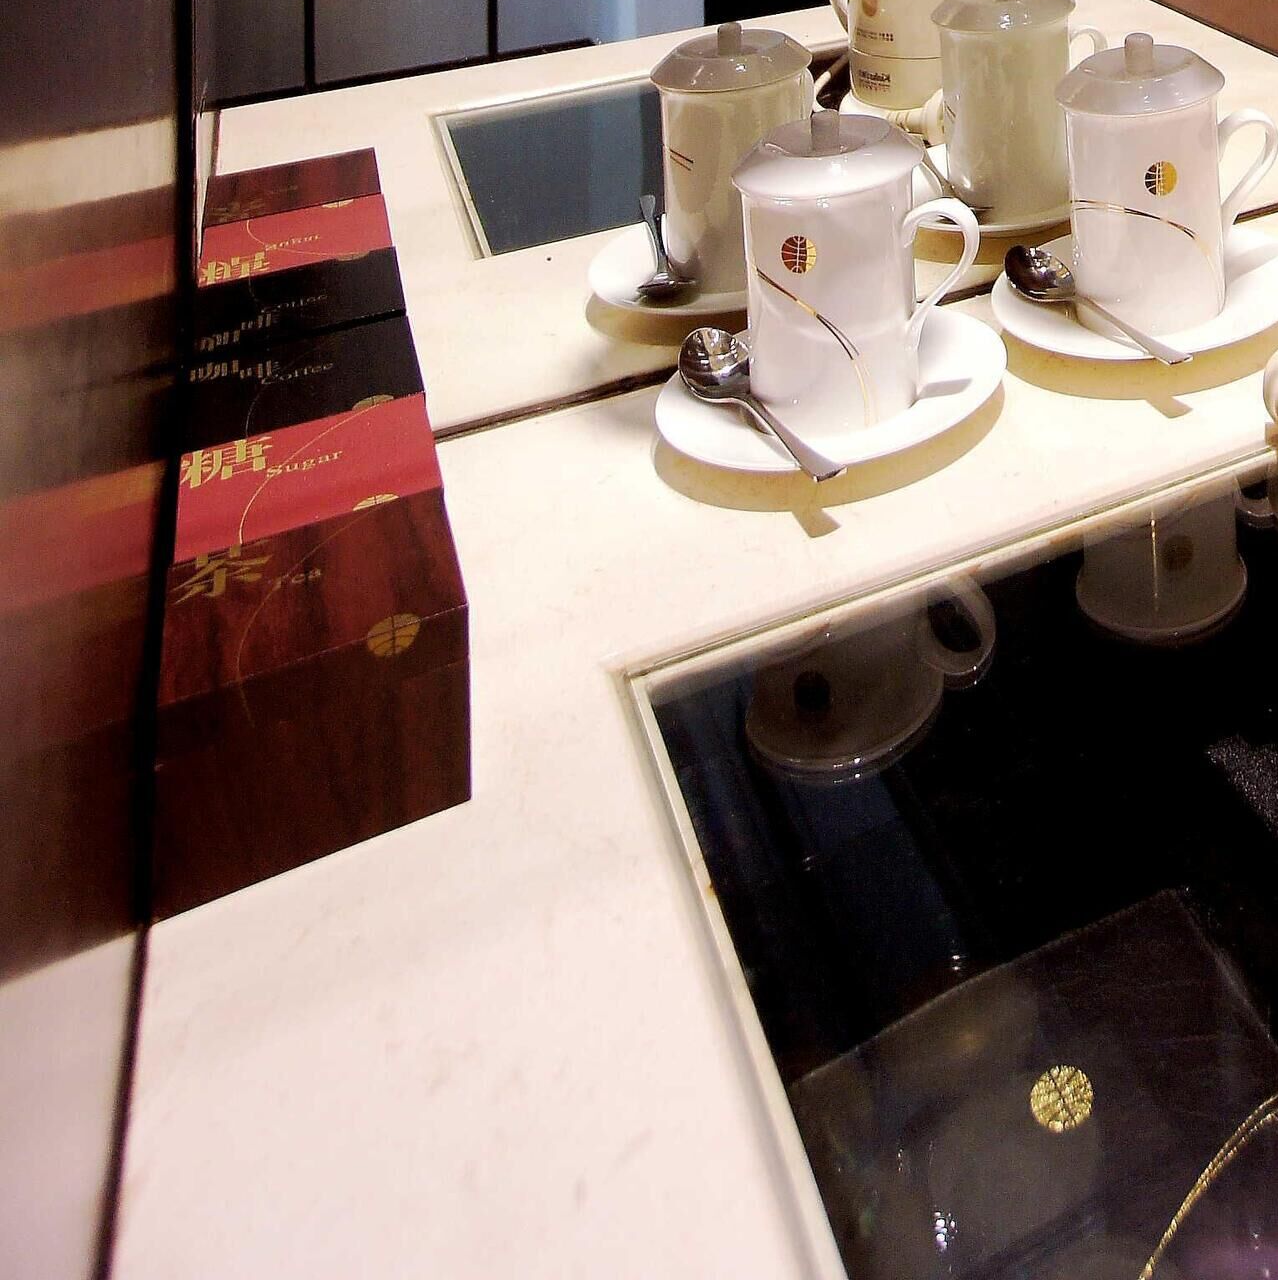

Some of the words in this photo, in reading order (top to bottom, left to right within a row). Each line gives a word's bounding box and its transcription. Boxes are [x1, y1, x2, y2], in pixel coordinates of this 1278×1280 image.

[181, 436, 273, 489] 糖
[266, 451, 343, 479] Sugar
[171, 540, 273, 606] 茶
